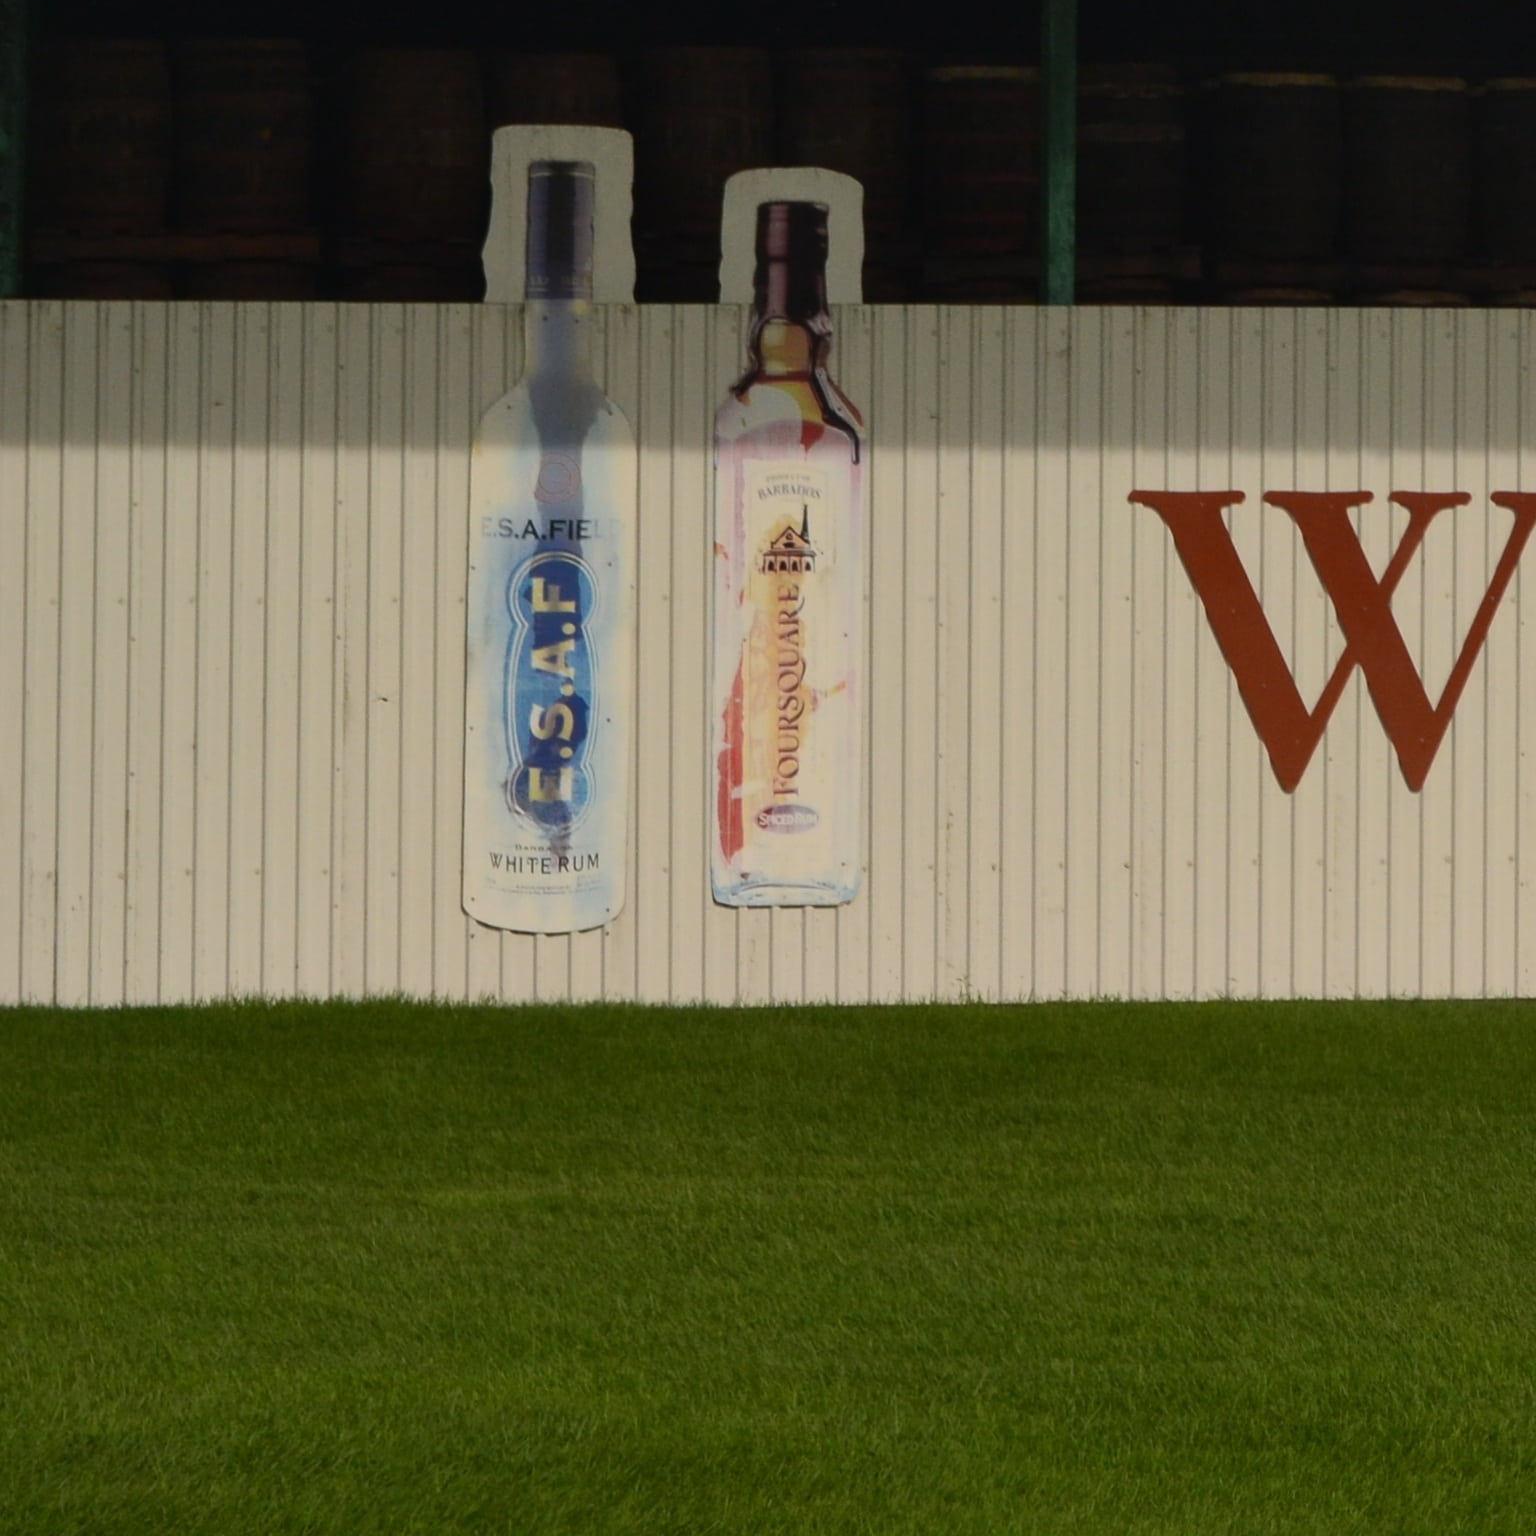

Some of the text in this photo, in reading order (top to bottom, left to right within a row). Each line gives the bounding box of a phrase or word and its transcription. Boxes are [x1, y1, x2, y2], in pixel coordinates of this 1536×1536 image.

[528, 575, 577, 802] E.S.A.F
[773, 583, 806, 797] FOURSQUARE
[489, 851, 600, 875] WHITE RUM
